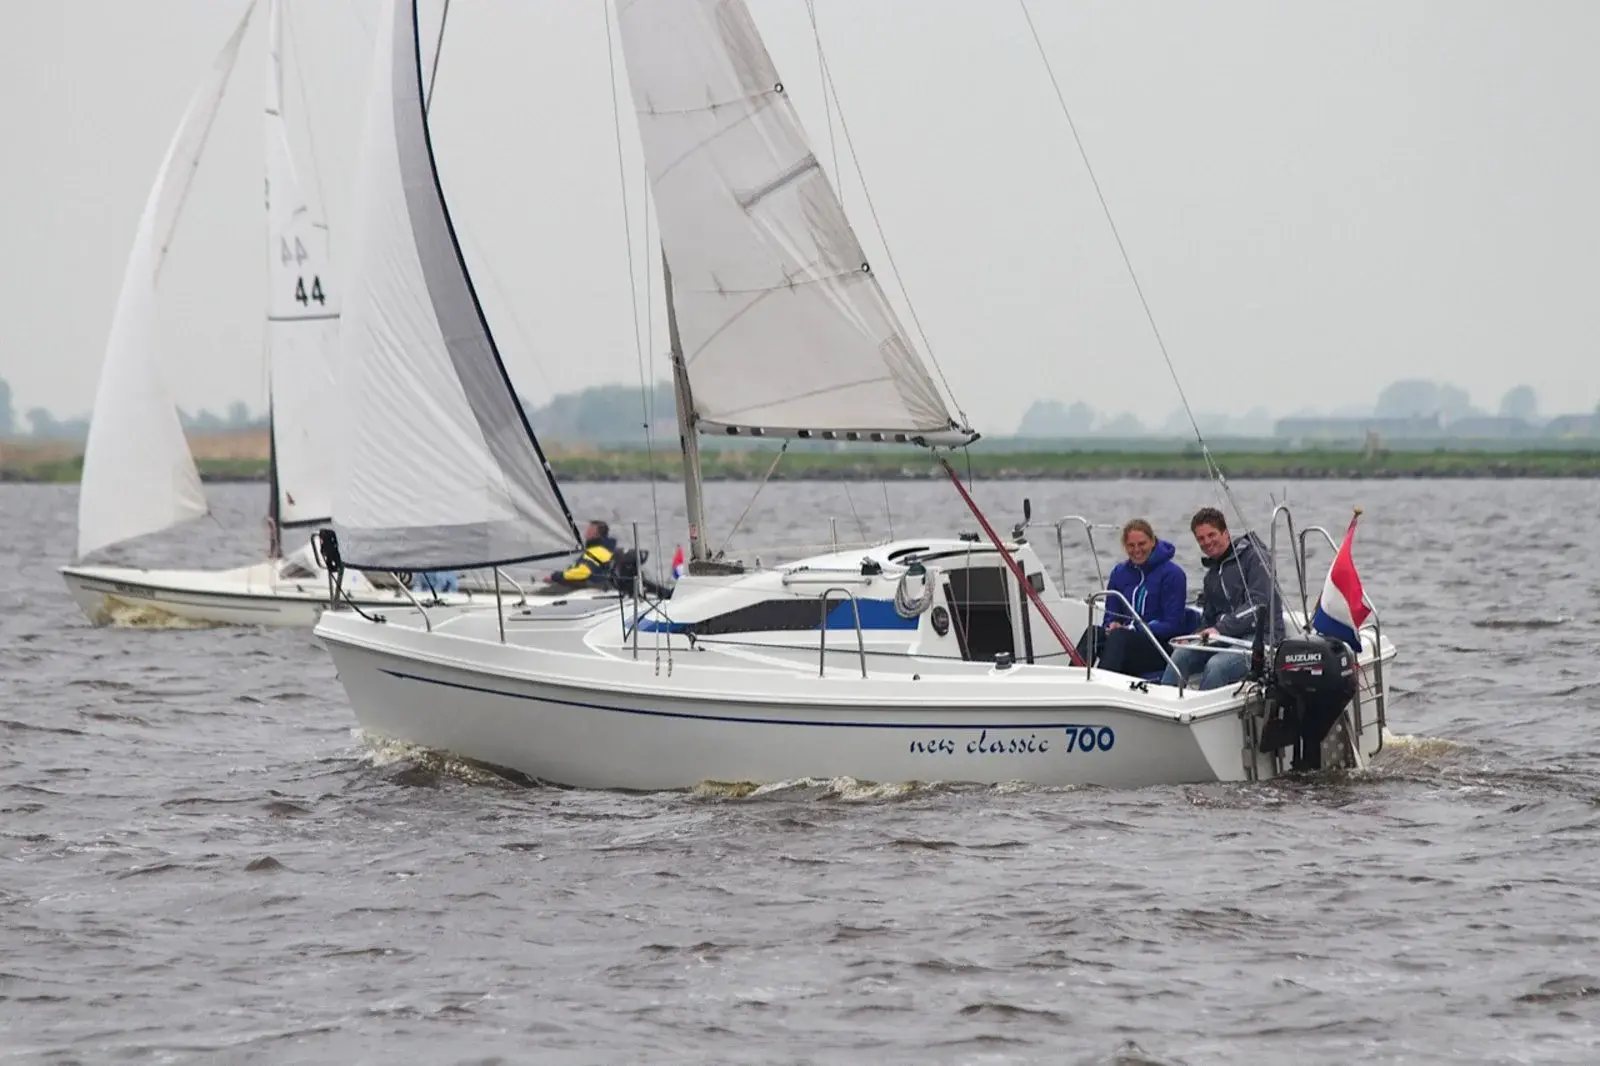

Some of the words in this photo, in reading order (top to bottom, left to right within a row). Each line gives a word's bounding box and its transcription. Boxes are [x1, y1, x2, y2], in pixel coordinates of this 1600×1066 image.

[295, 275, 325, 307] 44
[1285, 653, 1322, 663] SUZUKI
[910, 736, 955, 755] new
[966, 729, 1051, 754] classic
[1065, 726, 1115, 753] 700
